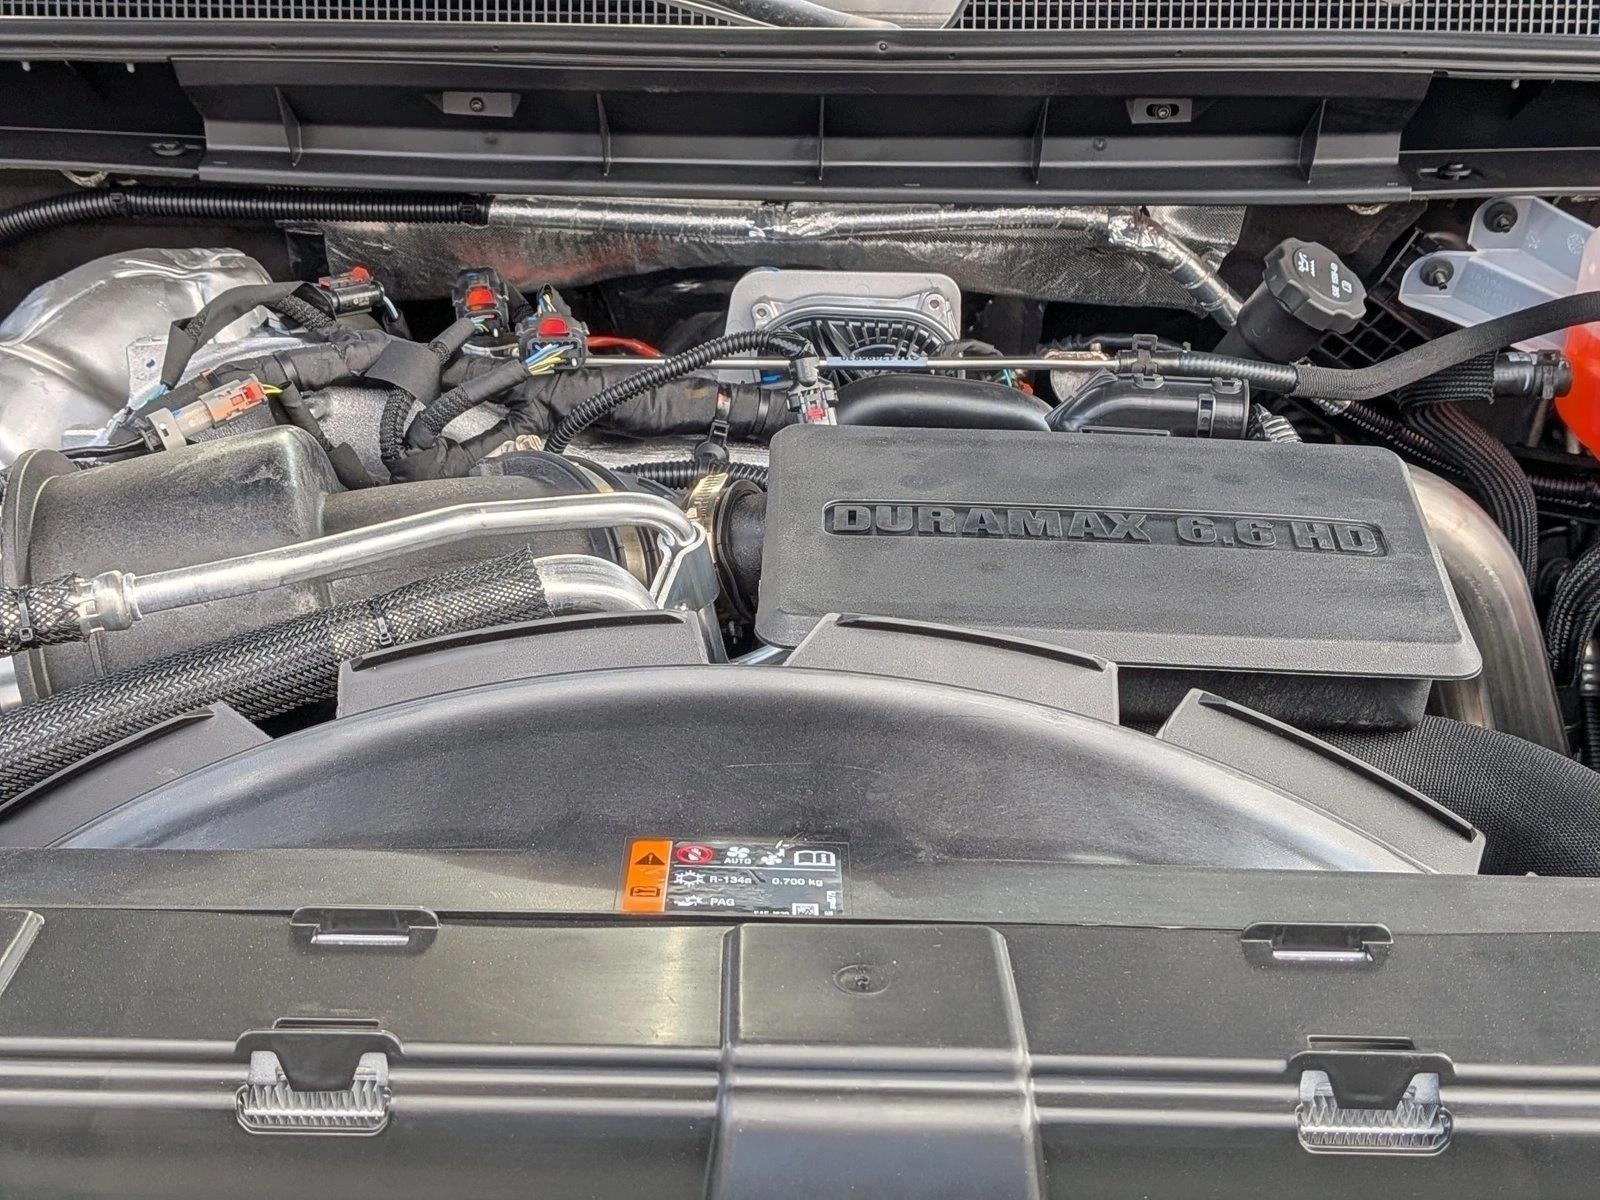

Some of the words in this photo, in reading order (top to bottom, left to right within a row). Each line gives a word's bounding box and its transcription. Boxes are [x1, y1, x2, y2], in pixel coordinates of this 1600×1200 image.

[833, 504, 1151, 542] DURAMAX
[1176, 515, 1276, 546] 6.6
[1290, 521, 1378, 553] HD
[723, 857, 752, 865] AUTO
[709, 875, 752, 885] R-134a
[771, 877, 806, 886] 0.700
[808, 878, 823, 888] kg
[710, 897, 736, 907] PAG
